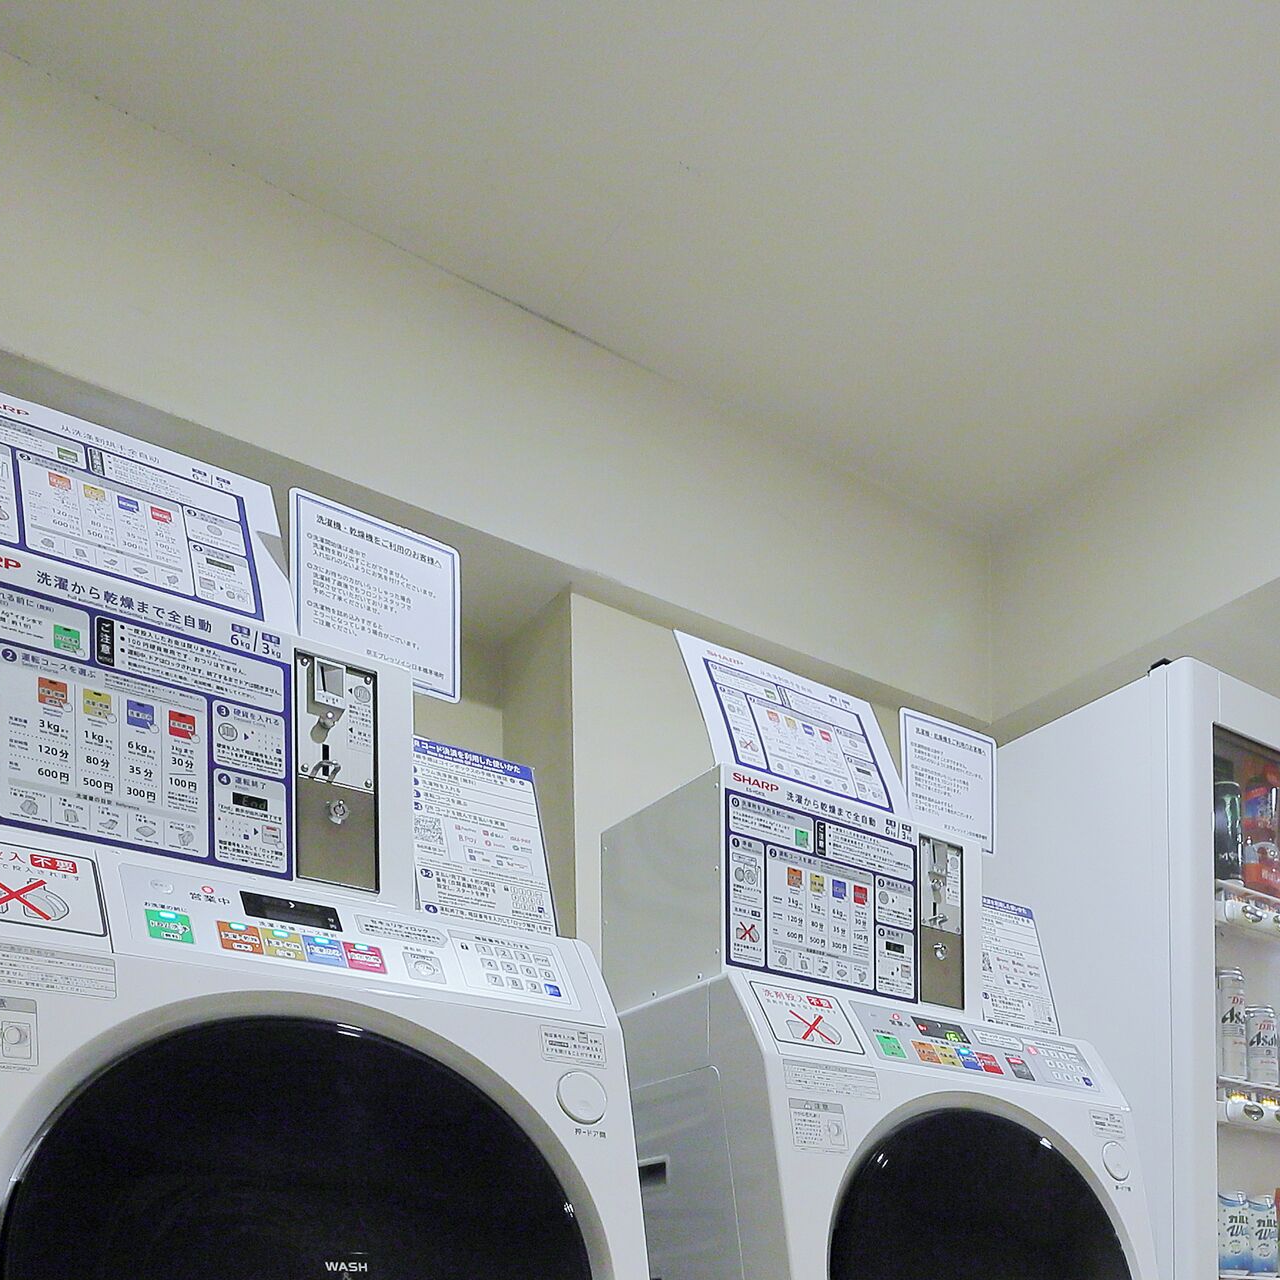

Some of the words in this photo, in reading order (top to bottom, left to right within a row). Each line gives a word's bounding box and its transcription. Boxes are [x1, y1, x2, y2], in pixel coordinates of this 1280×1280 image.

[316, 513, 442, 568] 洗濯機・乾燥機をご利用のお客様へ
[37, 570, 213, 633] 洗濯から乾燥まで全自動
[22, 652, 97, 679] 運転コースを選ぶ
[37, 767, 70, 783] 600円
[83, 777, 114, 792] 500円
[126, 786, 156, 801] 300円
[169, 776, 197, 791] 100円
[732, 772, 779, 793] SHARP
[786, 791, 876, 828] 洗濯から乾燥まで全自動
[34, 856, 74, 873] 不要
[189, 891, 230, 906] 営業中
[325, 1262, 368, 1272] WASH
